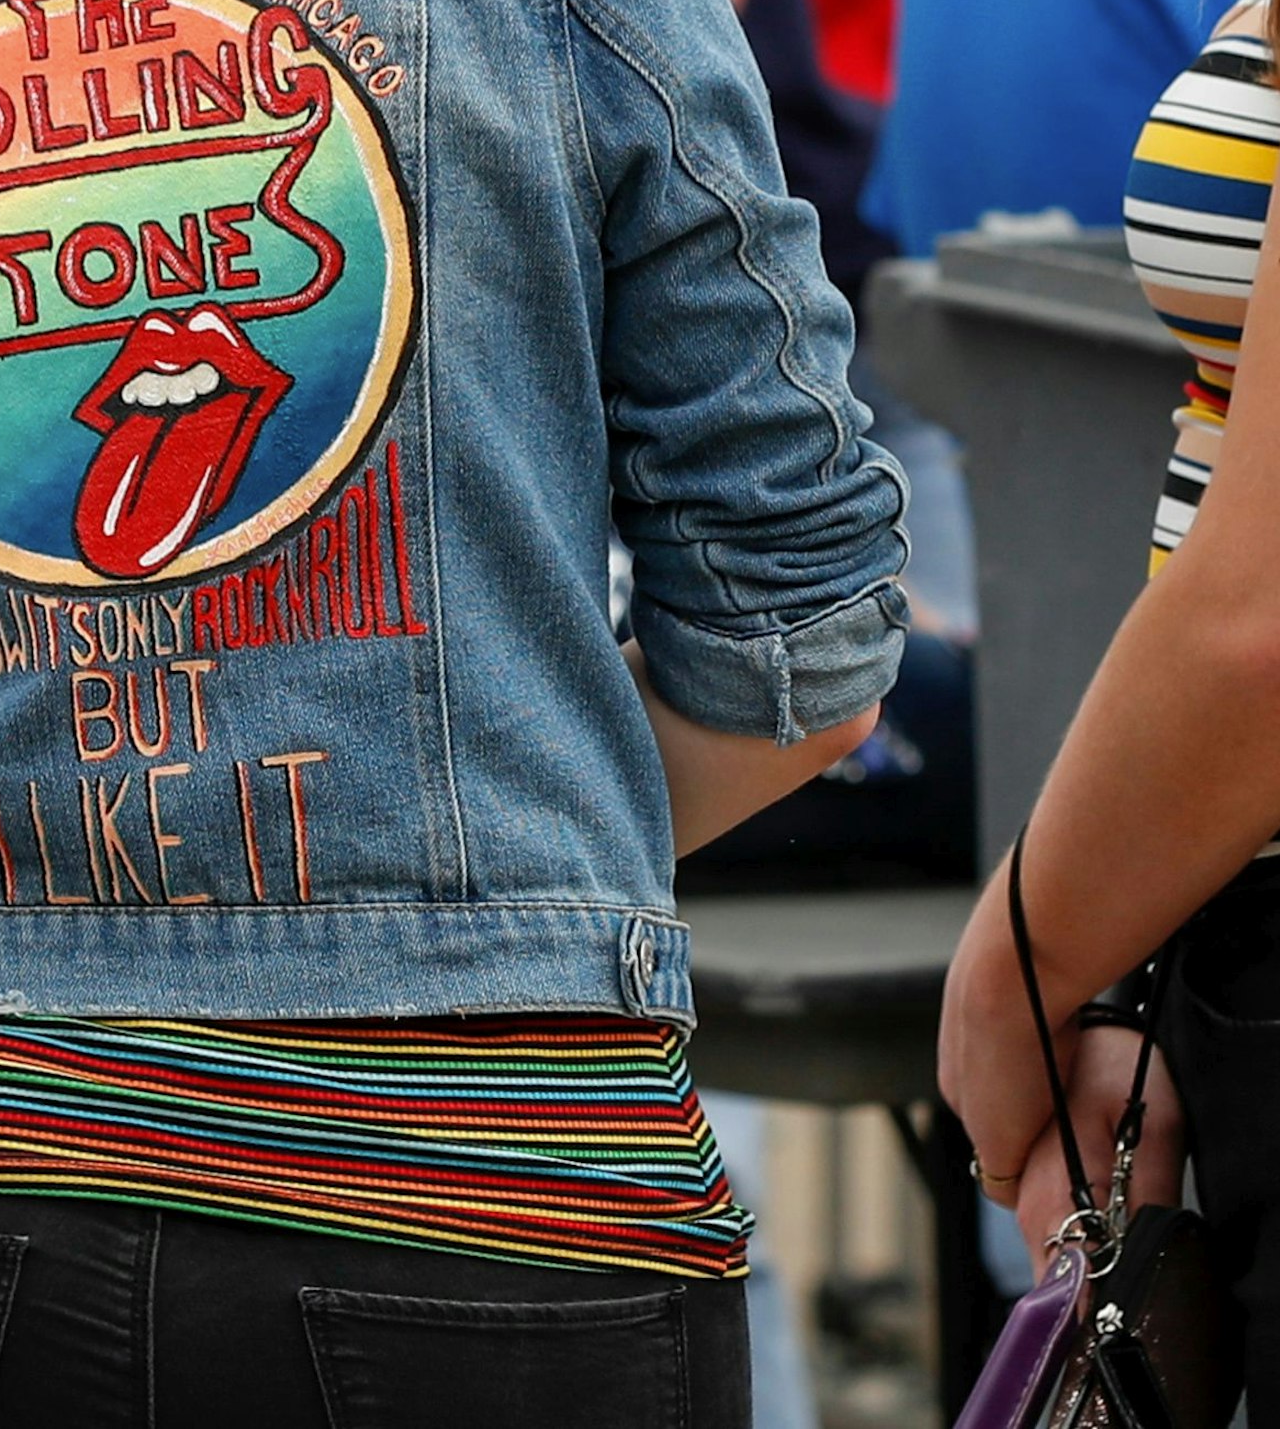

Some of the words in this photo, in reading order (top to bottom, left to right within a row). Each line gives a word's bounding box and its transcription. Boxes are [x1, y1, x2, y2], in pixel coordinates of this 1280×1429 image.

[70, 658, 219, 763] BUT
[27, 762, 214, 906] LIKE
[234, 750, 331, 904] IT
